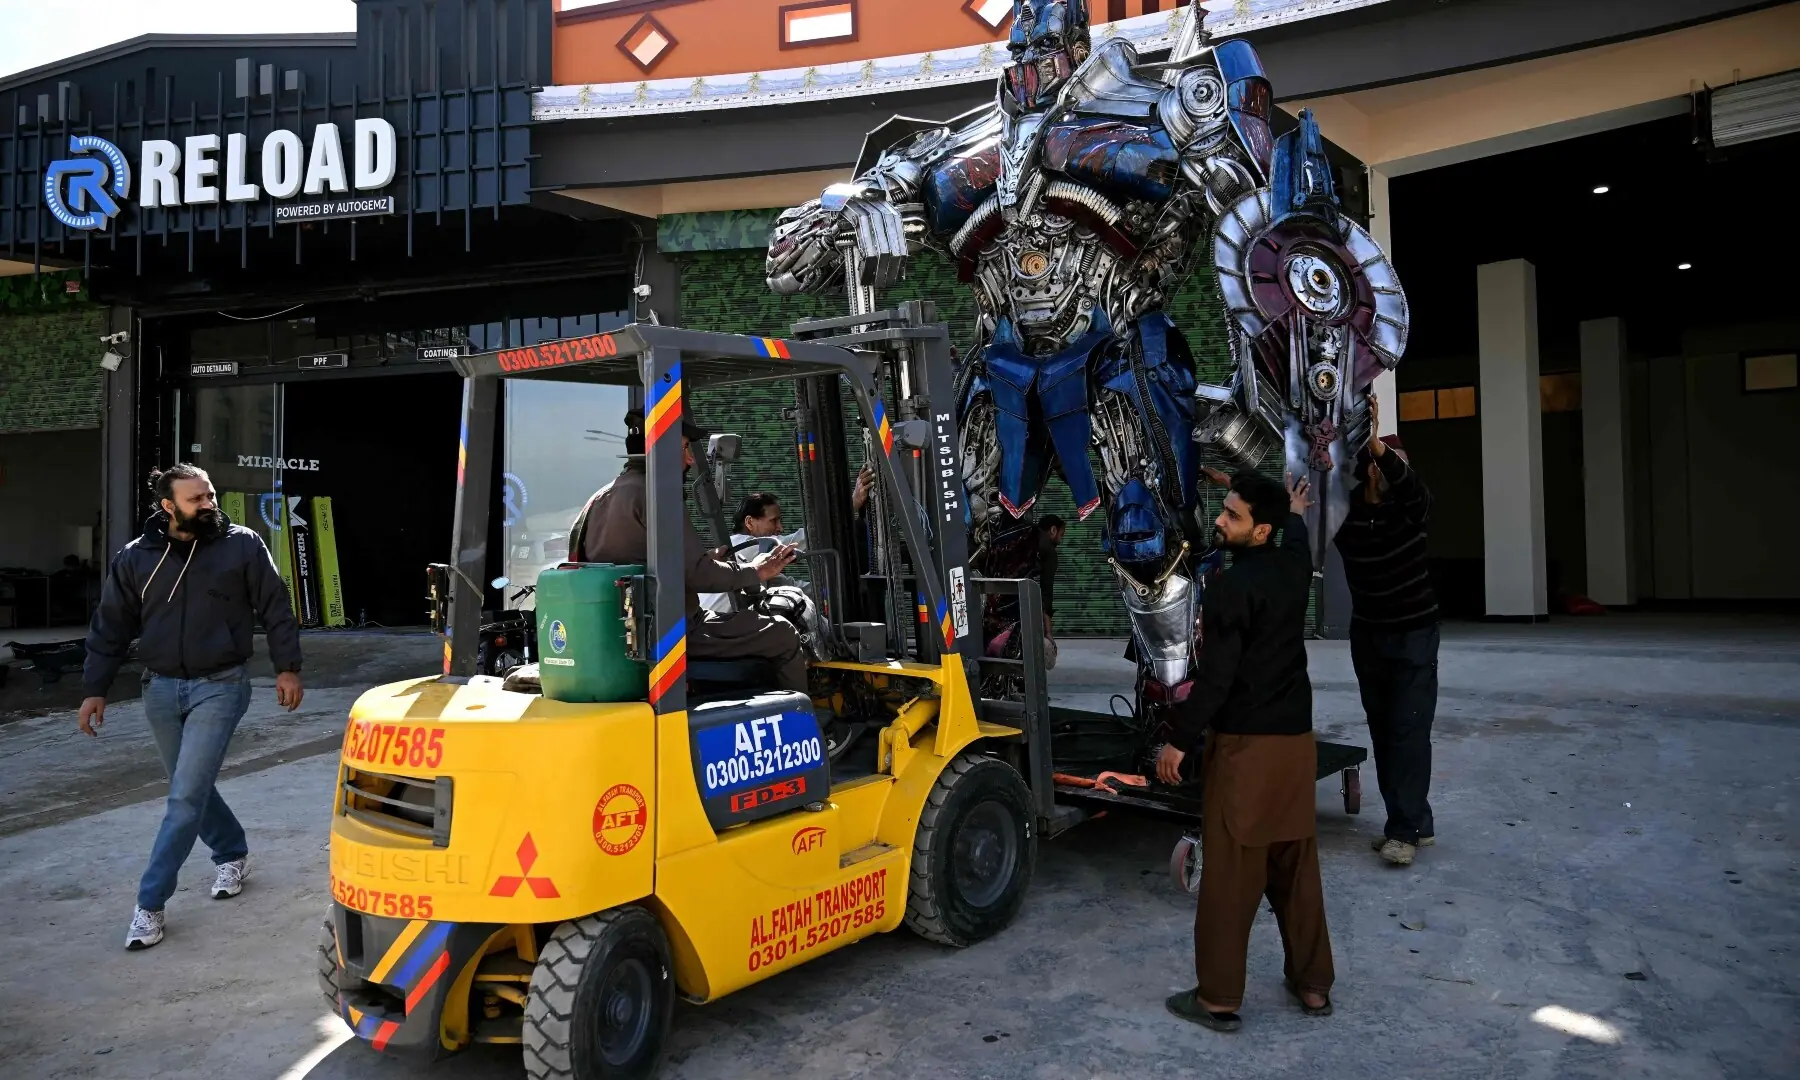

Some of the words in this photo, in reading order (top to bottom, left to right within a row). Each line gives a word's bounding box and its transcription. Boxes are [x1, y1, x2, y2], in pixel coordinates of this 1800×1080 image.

[140, 117, 397, 208] RELOAD
[276, 205, 321, 218] POWERED
[323, 203, 335, 214] BY
[336, 199, 387, 213] AUTOGEMZ
[313, 357, 328, 365] PPF
[423, 348, 458, 358] COATINGS
[498, 334, 617, 372] 0300.5212300
[192, 365, 206, 374] AUTO
[206, 364, 232, 373] DETAILING
[237, 454, 320, 471] MIRACLE
[936, 413, 958, 522] MITSUBISHI
[296, 532, 308, 577] MIRACLE
[735, 713, 783, 757] AFT
[706, 737, 821, 790] 0300.5212300
[619, 785, 645, 807] TRANSPORT
[737, 781, 800, 811] FD-3
[601, 810, 640, 830] AFT
[595, 825, 644, 853] 0300.5212300
[796, 831, 827, 856] AFT
[750, 896, 812, 948] AL.FATAH
[816, 868, 887, 921] TRANSPORT
[748, 900, 885, 972] 0301.5207585
